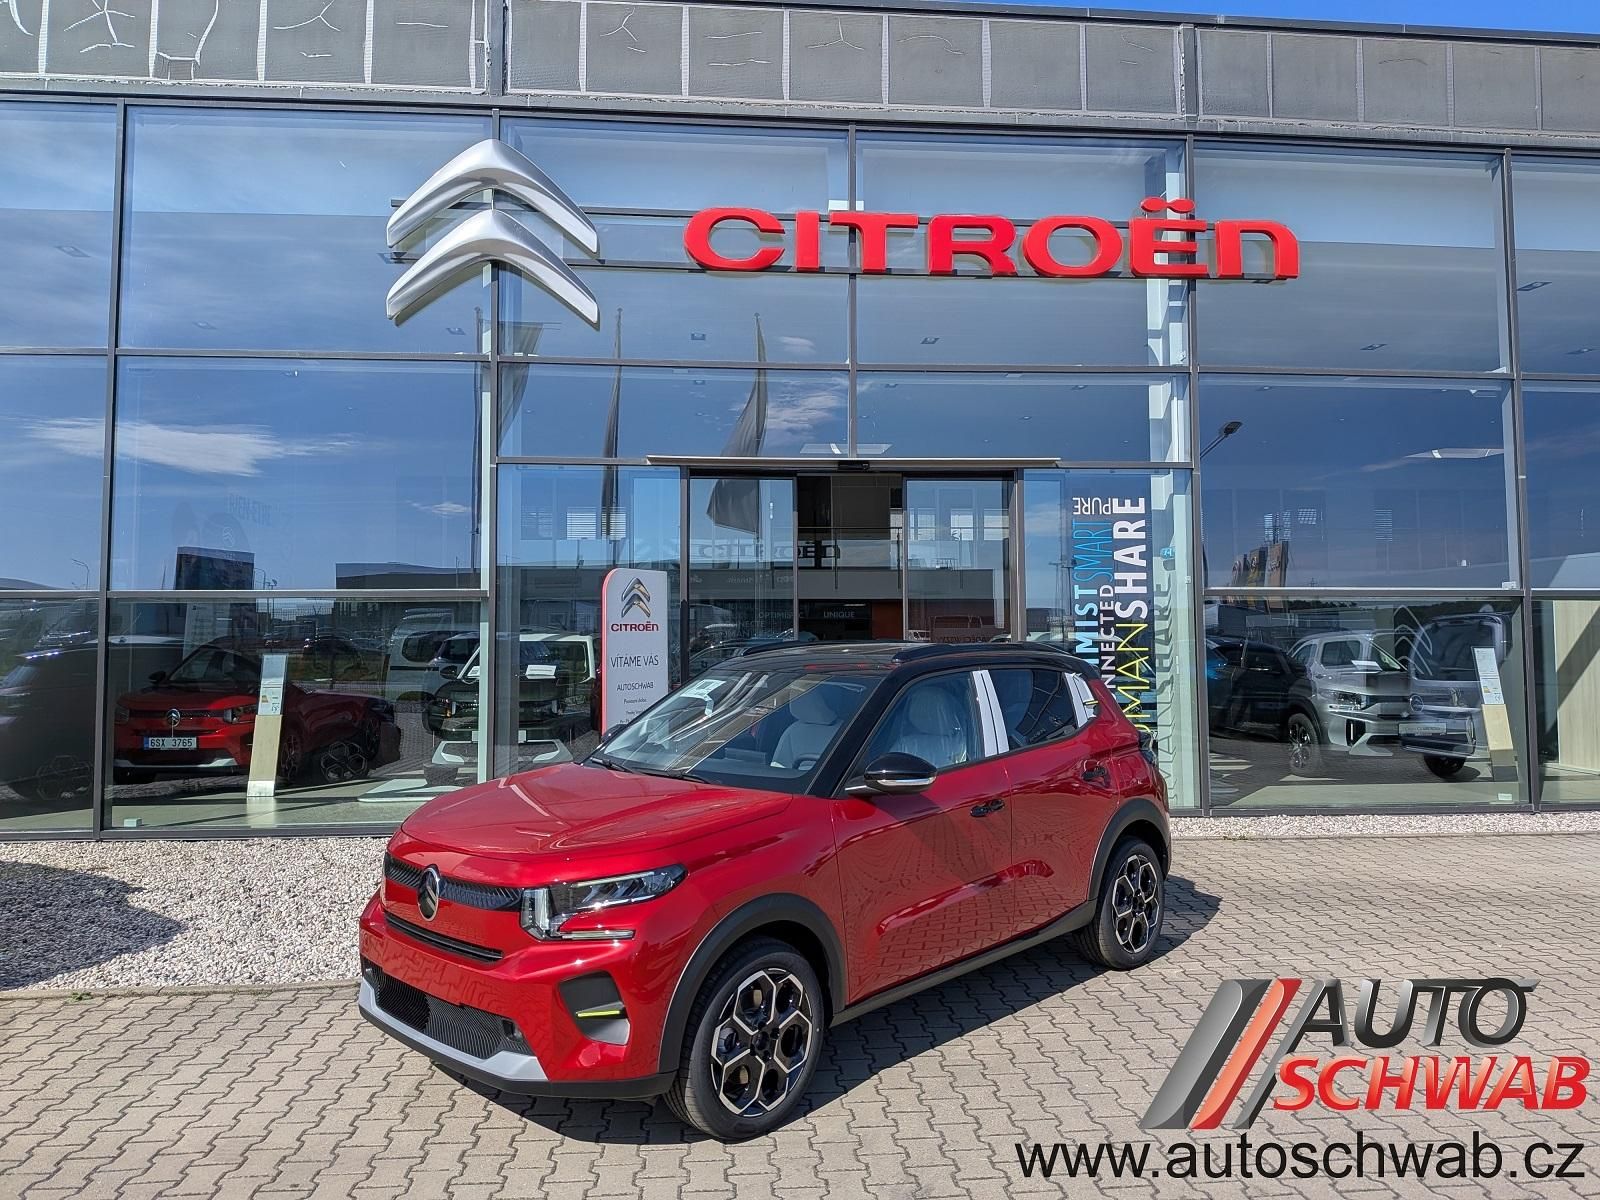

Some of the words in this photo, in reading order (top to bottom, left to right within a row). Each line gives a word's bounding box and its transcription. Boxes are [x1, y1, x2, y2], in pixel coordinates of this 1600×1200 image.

[683, 196, 1298, 280] CITROËN
[1072, 497, 1112, 515] PURE
[1072, 518, 1113, 582] SMART
[1112, 497, 1148, 619] SHARE
[823, 610, 856, 618] UNIQUE
[610, 621, 659, 632] CITROËN
[1100, 584, 1117, 700] NNECTED
[610, 653, 642, 668] VÍTÁME
[642, 653, 659, 666] VÁS
[150, 738, 166, 747] 6SX
[171, 738, 193, 747] 3765
